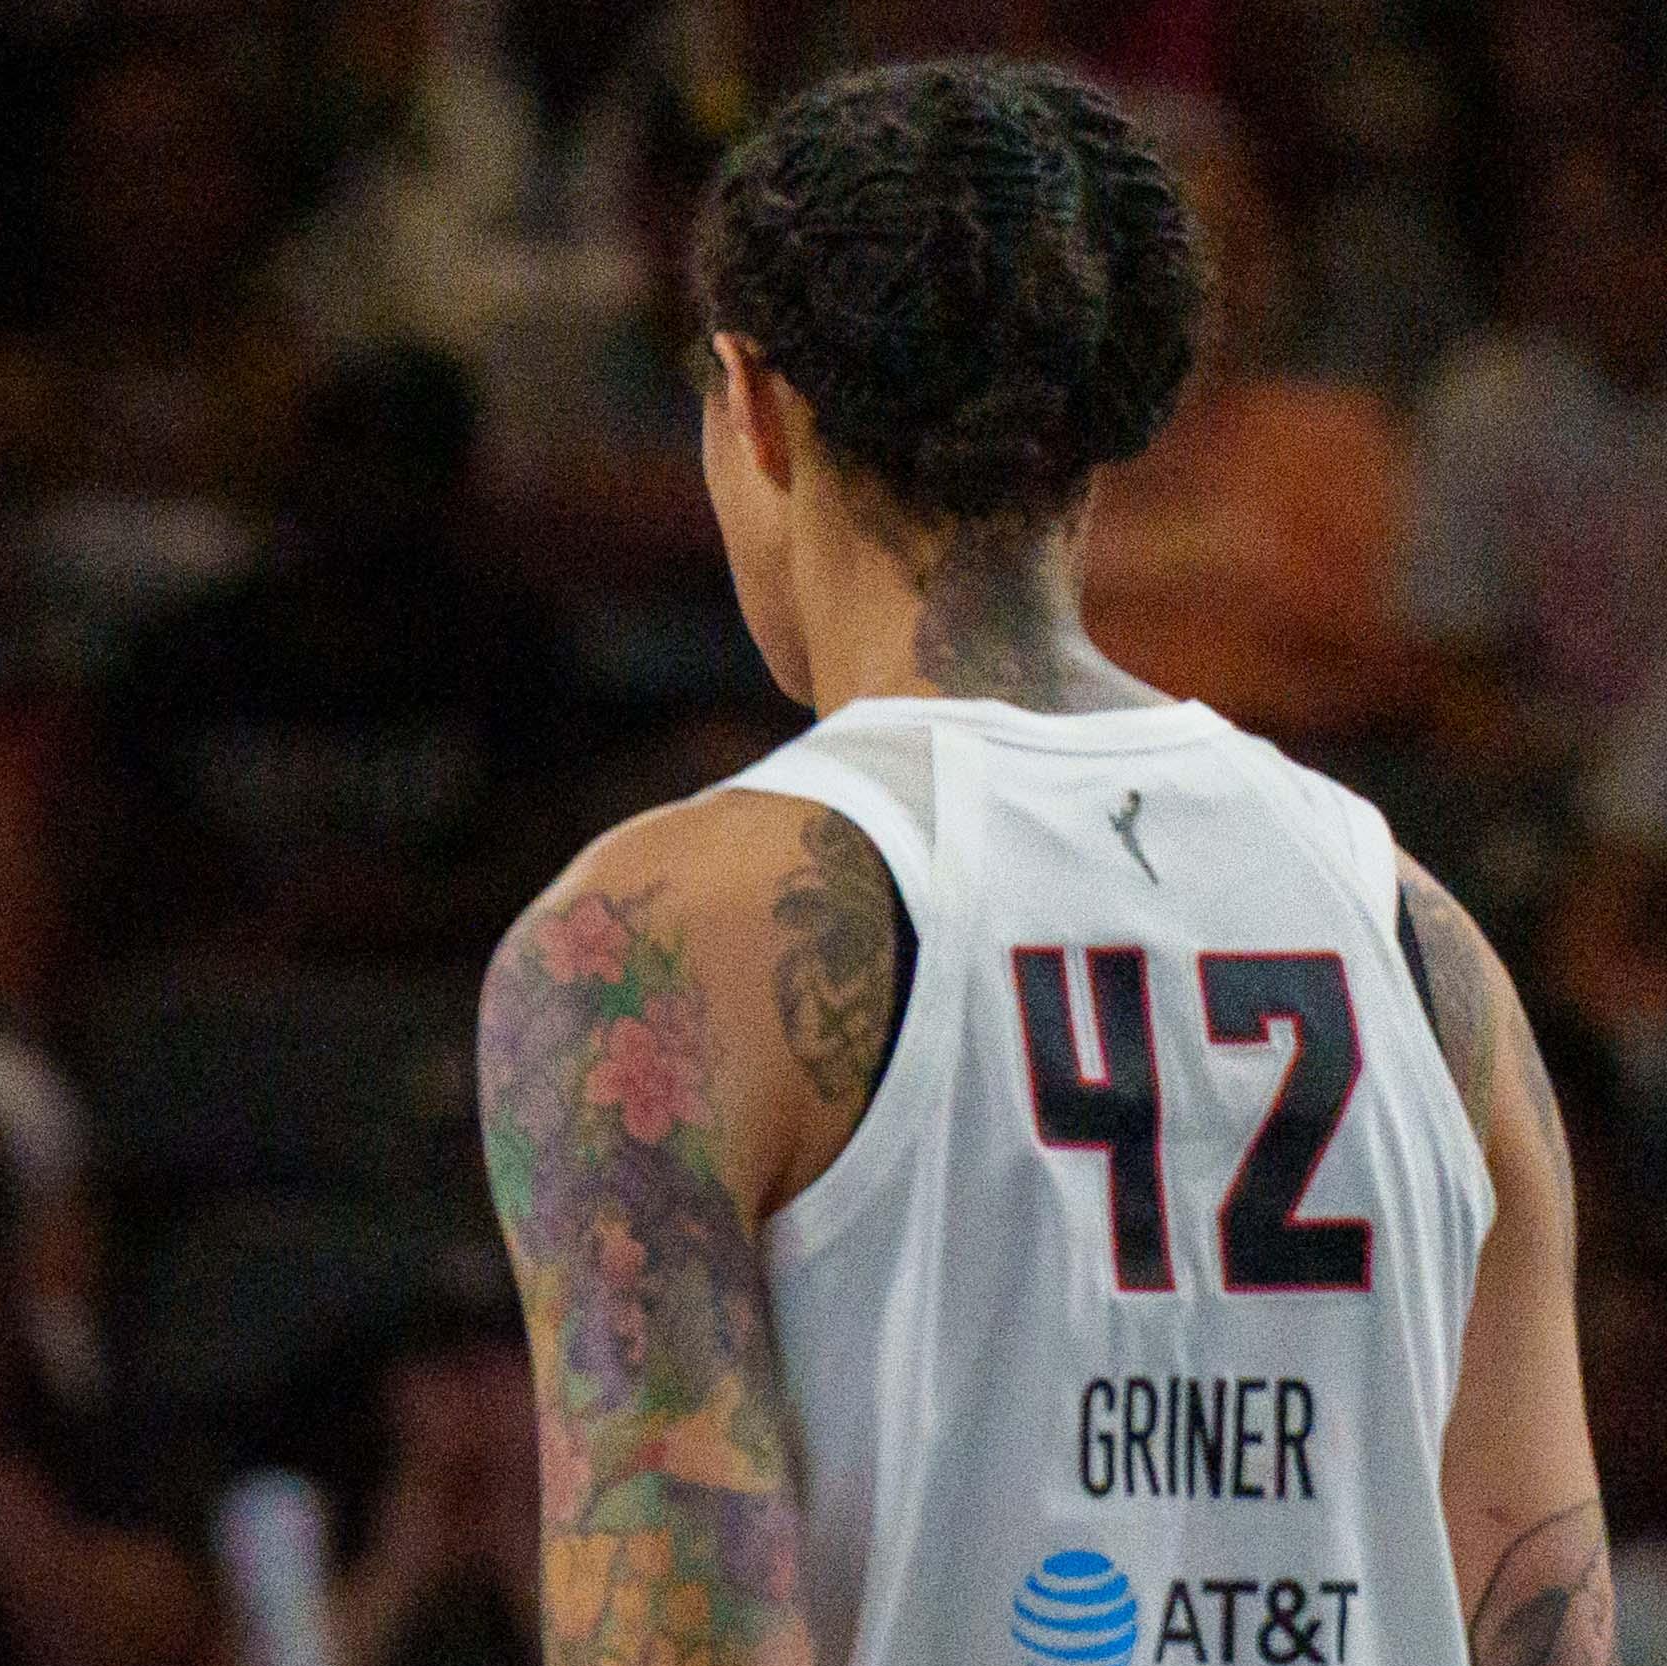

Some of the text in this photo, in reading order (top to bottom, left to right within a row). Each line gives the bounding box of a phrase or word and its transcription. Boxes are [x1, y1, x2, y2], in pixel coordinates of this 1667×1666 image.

[1010, 944, 1373, 1294] 42
[1078, 1376, 1316, 1499] GRINER
[1153, 1579, 1359, 1666] AT&T
